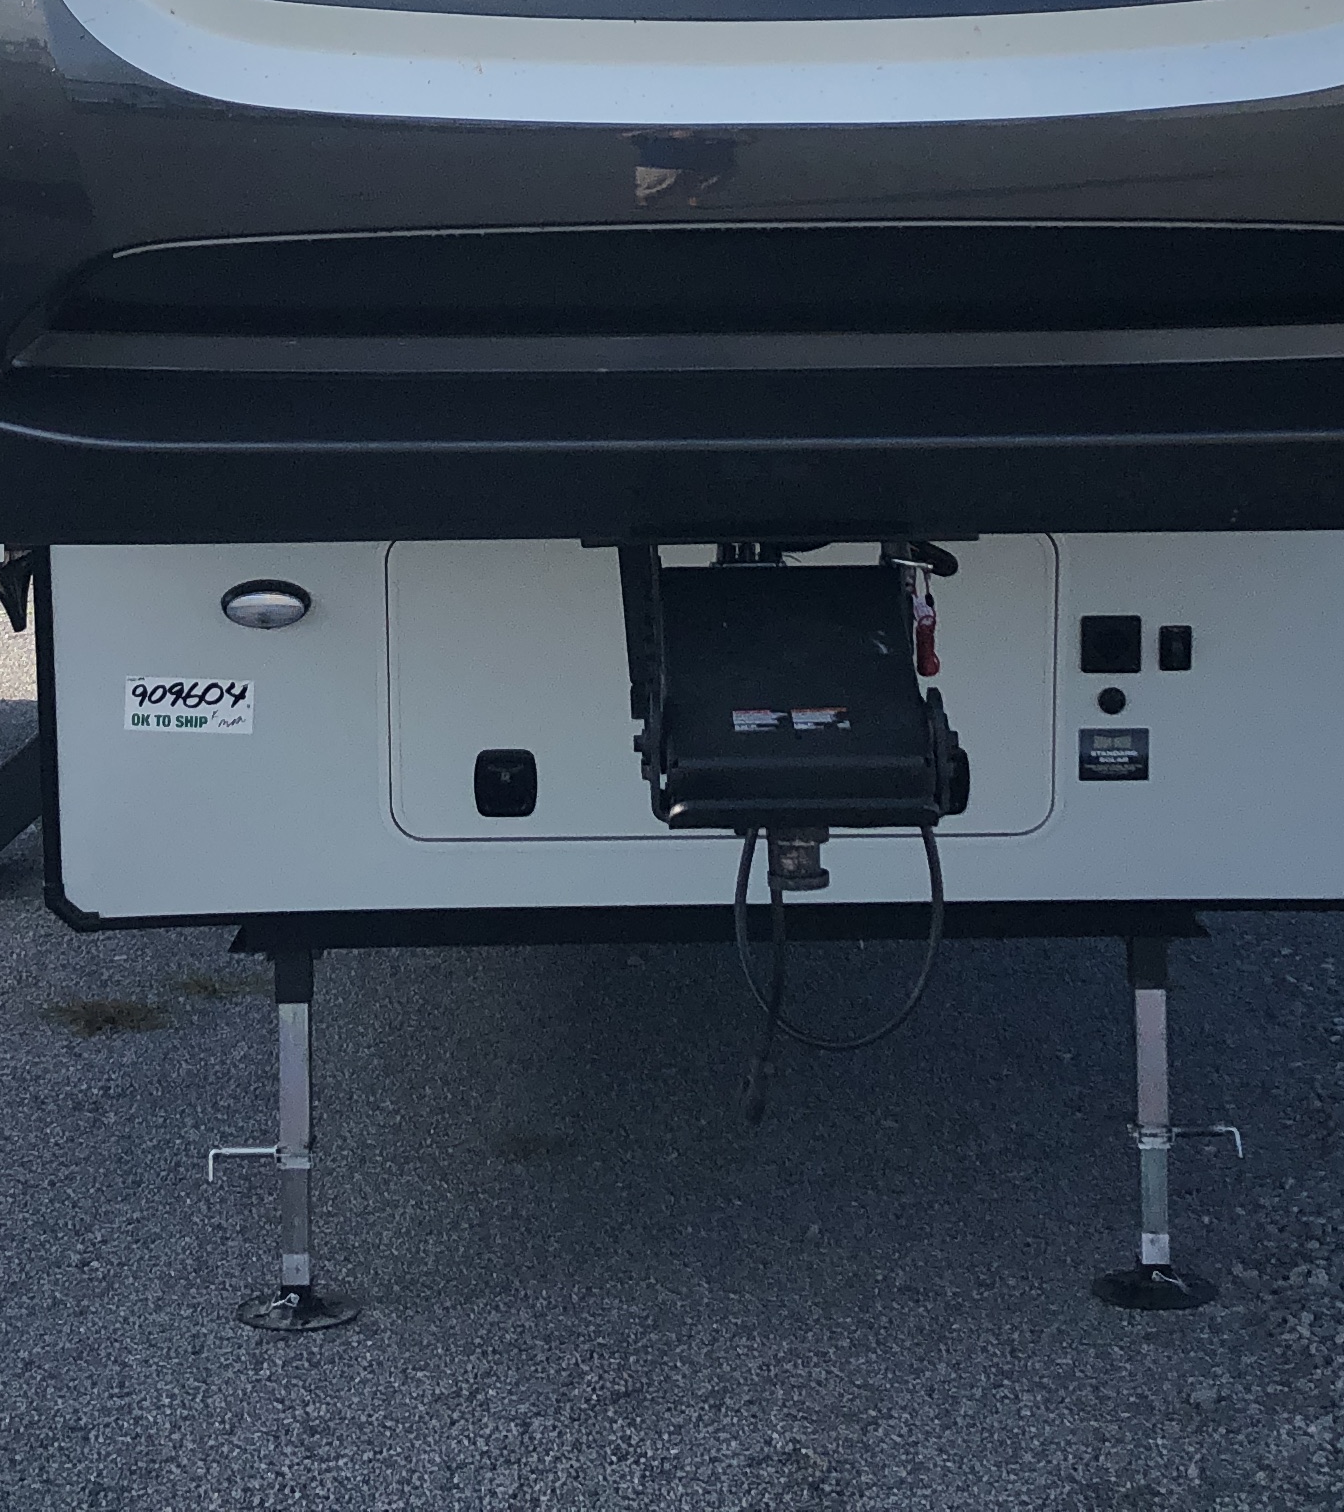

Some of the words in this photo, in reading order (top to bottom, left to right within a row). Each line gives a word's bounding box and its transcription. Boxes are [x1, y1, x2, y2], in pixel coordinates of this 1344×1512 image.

[131, 681, 248, 708] 909604
[131, 713, 151, 727] OK
[154, 714, 172, 728] TO
[175, 715, 208, 728] SHIP
